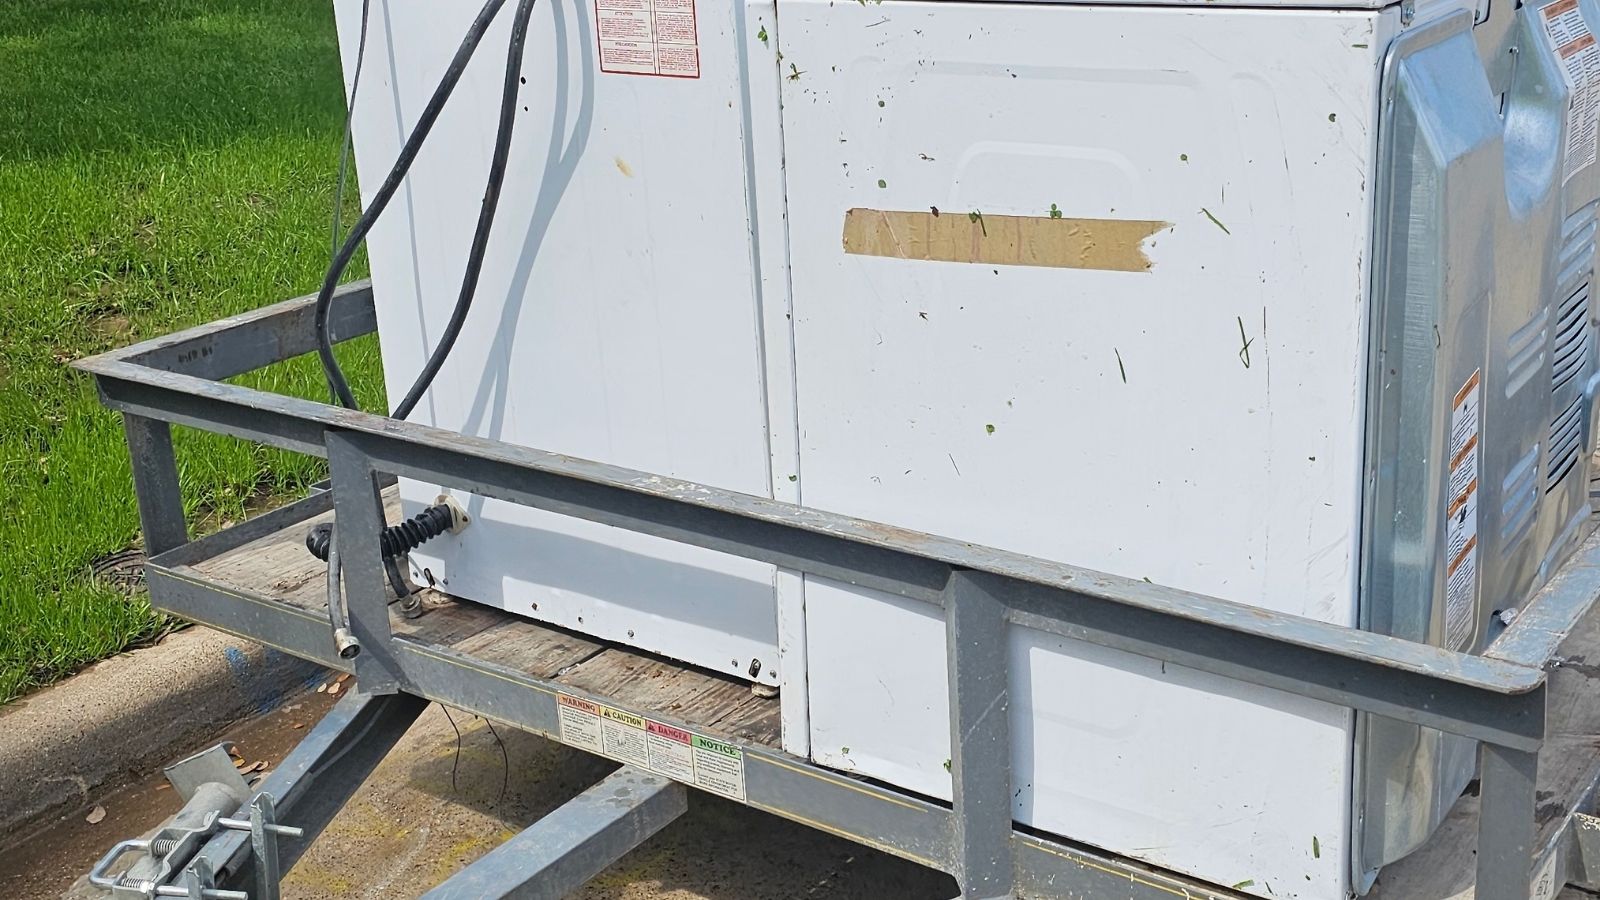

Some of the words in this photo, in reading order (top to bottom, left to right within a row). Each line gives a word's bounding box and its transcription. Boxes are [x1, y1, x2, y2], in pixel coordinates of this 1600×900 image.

[561, 696, 596, 712] WARNING
[612, 712, 642, 727] CAUTION
[658, 726, 689, 742] DANGER
[699, 738, 737, 756] NOTICE
